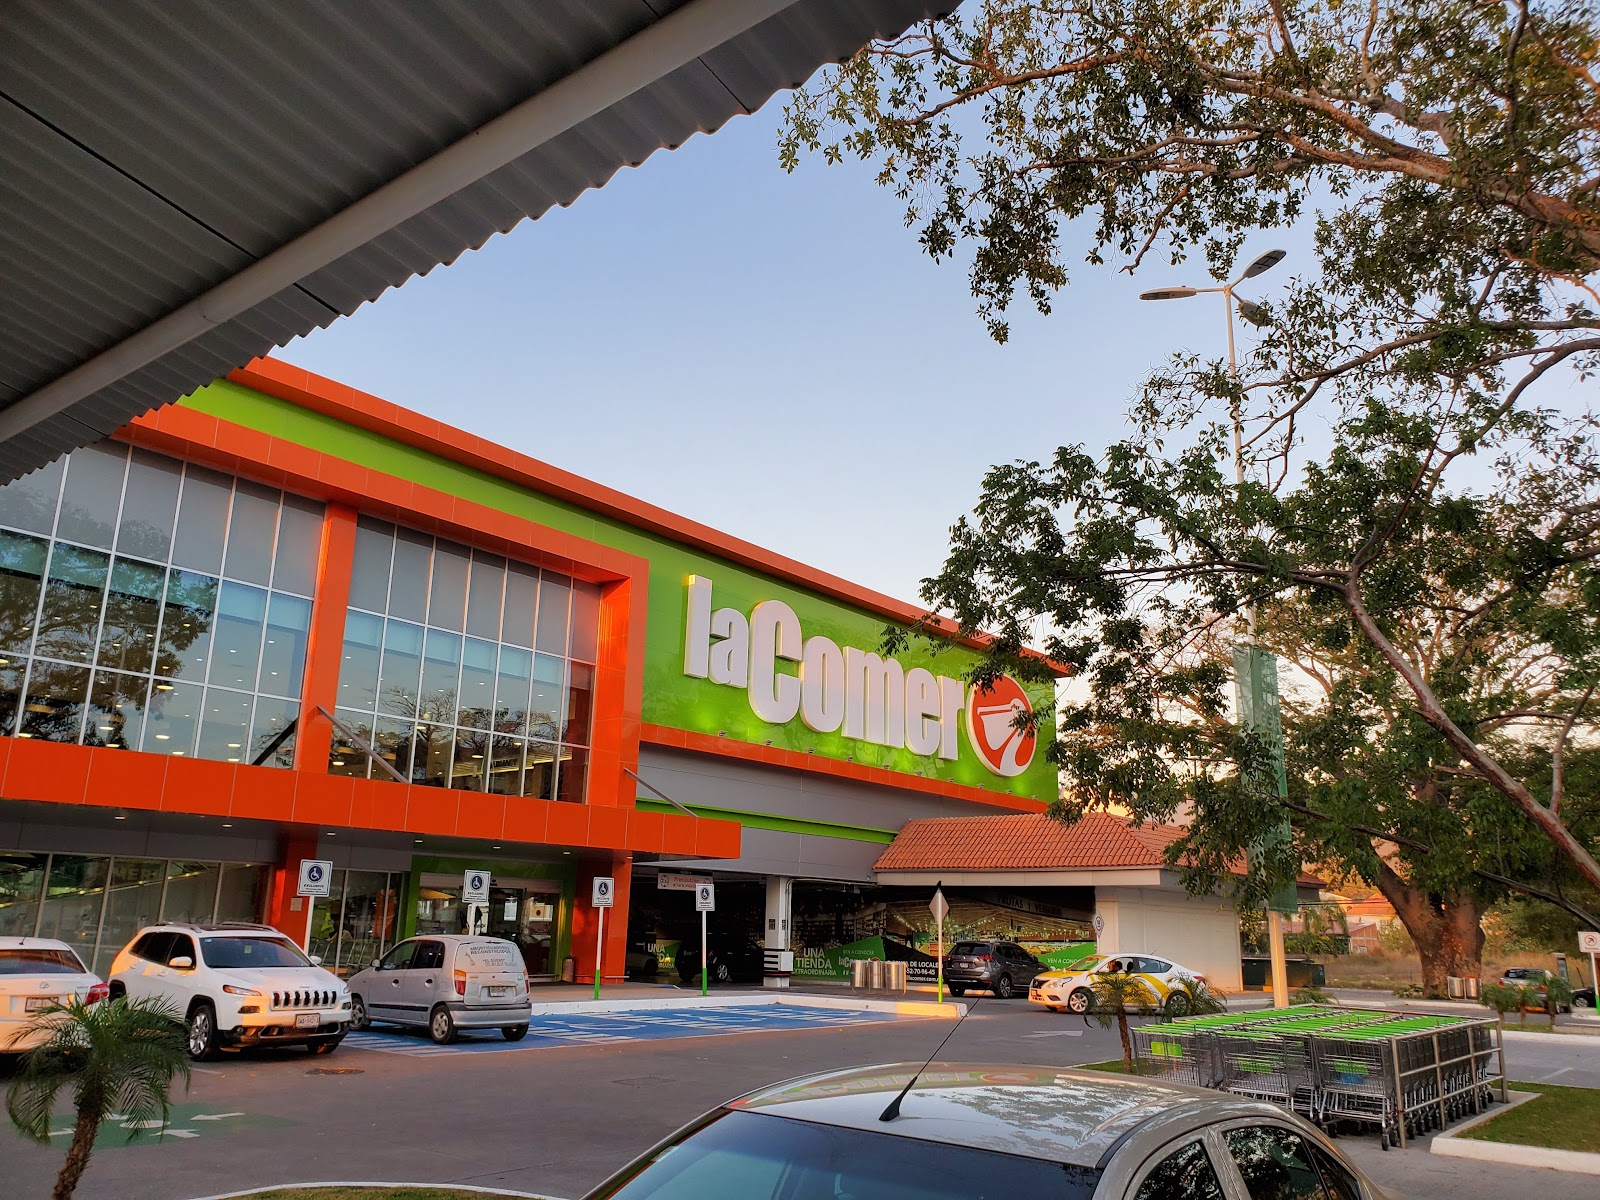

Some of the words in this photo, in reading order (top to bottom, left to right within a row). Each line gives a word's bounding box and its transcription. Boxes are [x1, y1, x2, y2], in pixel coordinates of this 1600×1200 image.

[684, 574, 965, 761] laComer
[803, 947, 826, 958] UNA
[795, 957, 832, 969] TIENDA
[909, 960, 918, 968] DE
